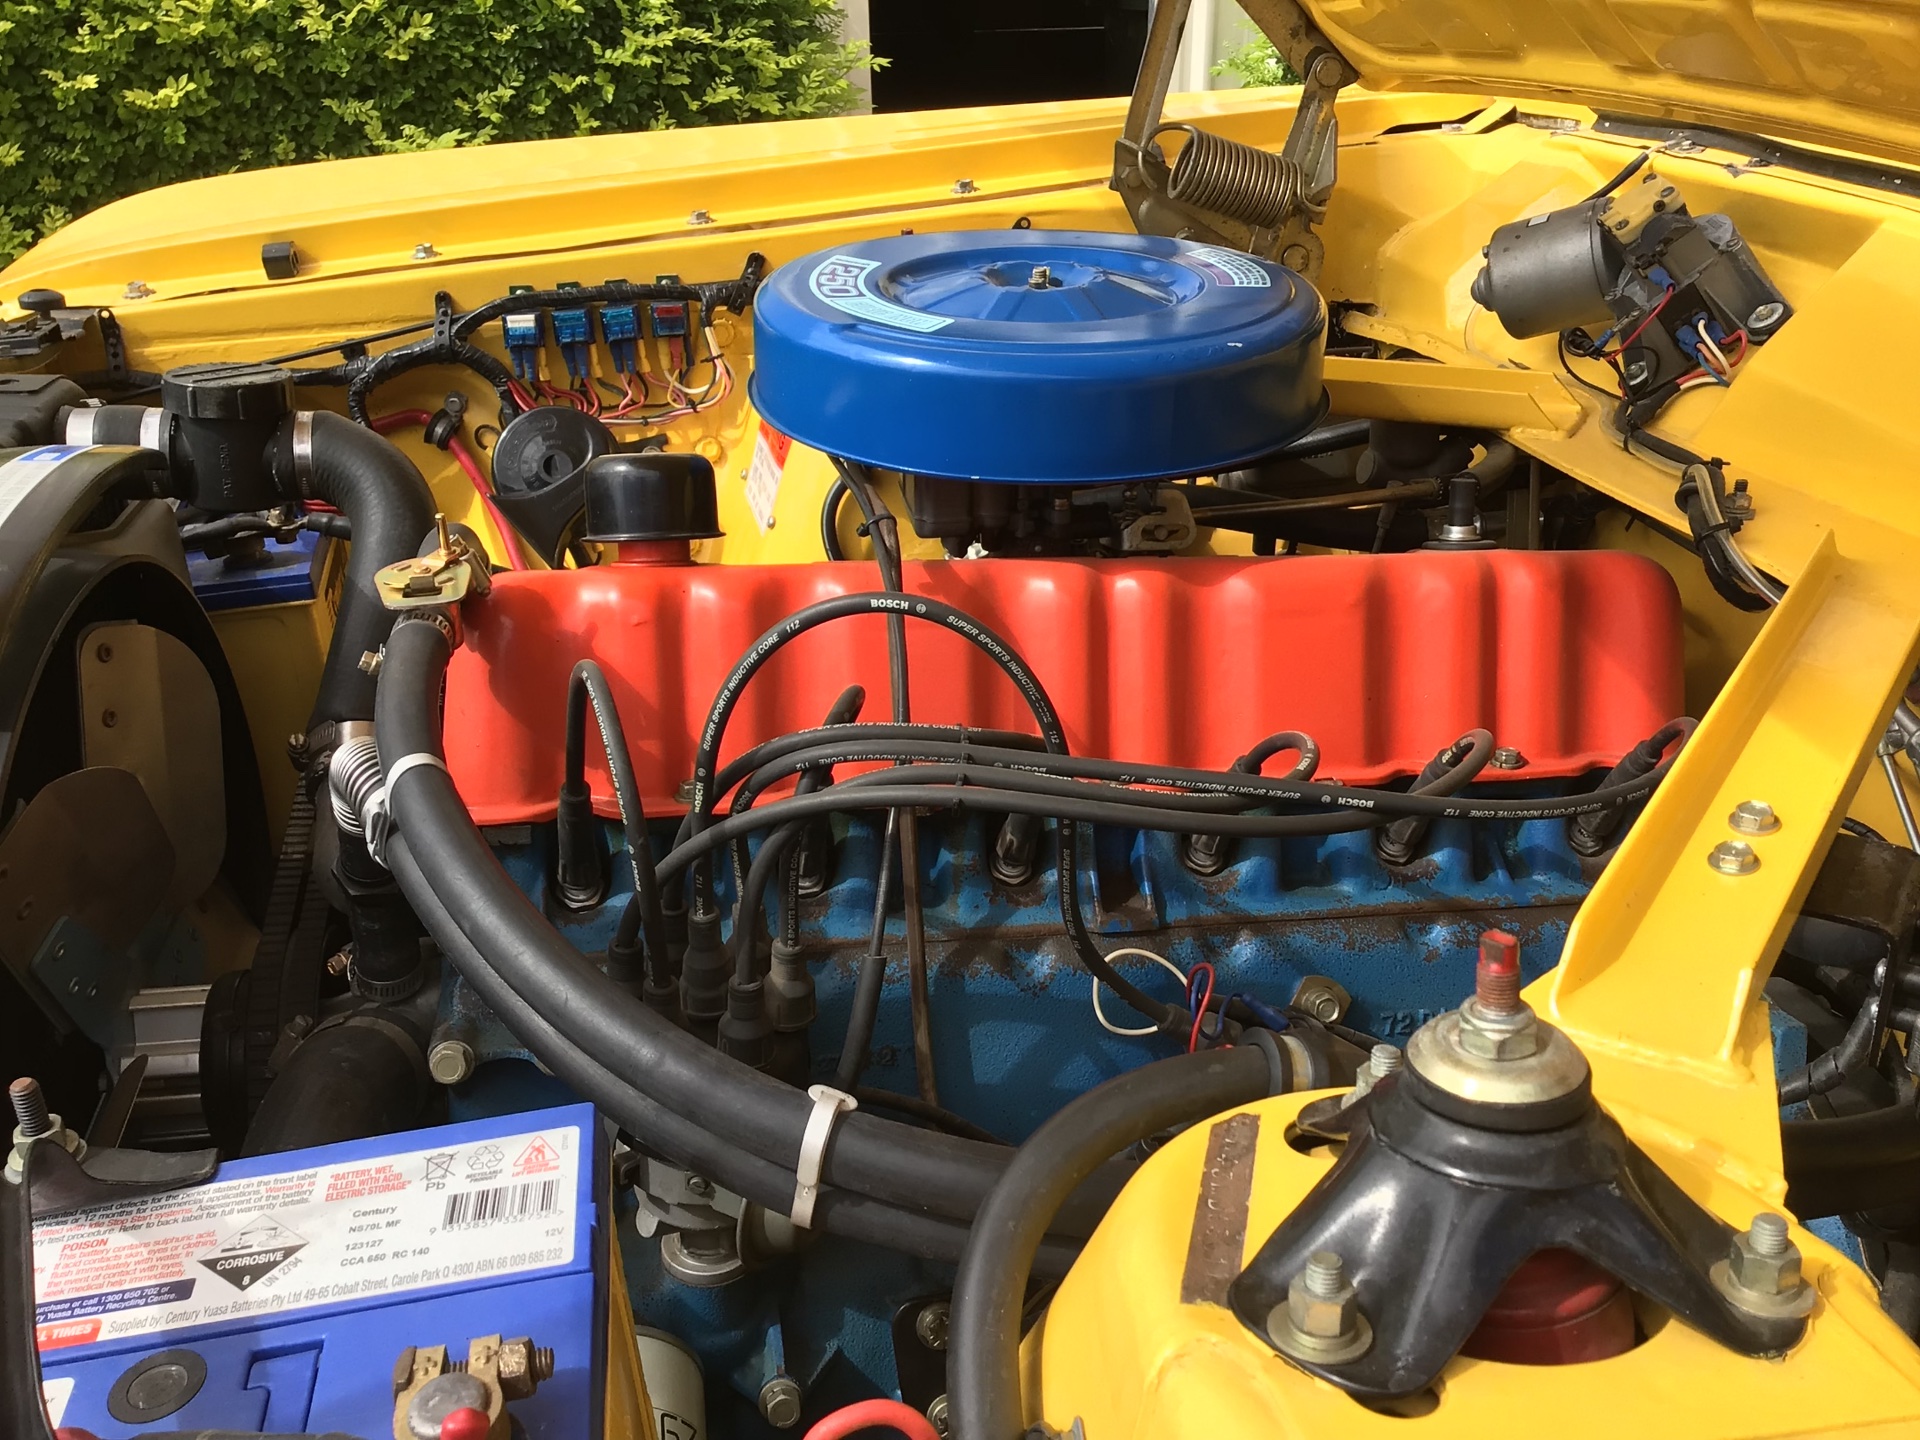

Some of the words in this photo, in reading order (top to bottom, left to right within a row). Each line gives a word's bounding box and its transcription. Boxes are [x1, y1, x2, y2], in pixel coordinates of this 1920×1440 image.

[818, 263, 862, 297] 250
[870, 598, 909, 610] BOSCH
[947, 615, 979, 636] SUPER
[978, 634, 1011, 662] SPORTS
[593, 698, 609, 746] INDUCTIVE
[694, 781, 704, 813] BOSCH
[703, 722, 716, 751] SUPER
[711, 689, 731, 723] SPORTS
[727, 650, 759, 692] INDUCTIVE
[758, 632, 780, 654] CORE
[786, 619, 800, 633] 112
[605, 747, 620, 788] SPORTS
[1175, 780, 1226, 791] INDUCTIVE
[1227, 785, 1265, 796] SPORTS
[1267, 789, 1301, 800] SUPER
[616, 791, 628, 825] SUPER
[1338, 796, 1374, 808] BOSCH
[1444, 808, 1460, 816] 112
[1542, 806, 1576, 818] SPORTS
[1576, 802, 1602, 814] SUPER
[1468, 809, 1495, 818] CORE
[1495, 809, 1543, 818] INDUCTIVE
[788, 871, 797, 908] INDUCTIVE
[788, 909, 796, 938] SPORTS
[115, 1199, 149, 1211] defects
[150, 1195, 164, 1206] for
[165, 1193, 180, 1201] the
[181, 1187, 211, 1201] period
[212, 1184, 241, 1196] stated
[256, 1178, 272, 1188] the
[273, 1175, 296, 1185] front
[296, 1171, 319, 1182] label
[327, 1180, 356, 1192] FILLED
[358, 1175, 384, 1187] WITH
[385, 1172, 403, 1184] ACID
[425, 1181, 446, 1192] Pb
[84, 1214, 97, 1222] 12
[97, 1208, 133, 1220] months
[135, 1206, 148, 1215] for
[149, 1196, 205, 1212] commercial
[265, 1182, 306, 1195] Warranty
[325, 1187, 366, 1202] ELECTRIC
[130, 1213, 153, 1223] Start
[195, 1197, 253, 1212] Assessment
[253, 1196, 264, 1204] of
[265, 1192, 280, 1202] the
[281, 1188, 315, 1200] battery
[352, 1205, 398, 1218] Century
[118, 1223, 142, 1233] Refer
[145, 1221, 155, 1229] to
[156, 1217, 179, 1228] back
[181, 1213, 204, 1224] label
[205, 1211, 219, 1220] for
[220, 1207, 235, 1218] full
[236, 1203, 277, 1215] warranty
[348, 1221, 383, 1234] NS70L
[385, 1219, 402, 1229] MF
[429, 1227, 437, 1236] 9
[545, 1227, 565, 1238] 12V
[61, 1238, 109, 1253] POISON
[62, 1259, 82, 1269] acid
[83, 1255, 123, 1267] contacts
[147, 1246, 169, 1257] eyes
[182, 1237, 217, 1250] clothing
[79, 1247, 112, 1258] battery
[112, 1242, 151, 1253] contains
[345, 1239, 384, 1251] 123127
[75, 1261, 131, 1276] immediately
[133, 1256, 154, 1266] with
[216, 1250, 285, 1271] CORROSIVE
[340, 1255, 365, 1267] CCA
[367, 1252, 387, 1263] 650
[391, 1249, 408, 1260] RC
[411, 1247, 430, 1257] 140
[63, 1275, 89, 1286] event
[103, 1268, 138, 1280] contact
[140, 1263, 160, 1274] with
[242, 1275, 251, 1286] 8
[261, 1273, 280, 1288] UN
[278, 1256, 304, 1276] 2794
[67, 1282, 105, 1295] medical
[106, 1277, 127, 1289] help
[83, 1296, 98, 1306] call
[101, 1293, 122, 1304] 1300
[123, 1290, 141, 1300] 650
[142, 1287, 160, 1297] 702
[161, 1285, 171, 1293] or
[108, 1318, 148, 1334] Supplied
[150, 1314, 163, 1328] by:
[165, 1308, 201, 1324] Century
[203, 1305, 229, 1318] Yuasa
[230, 1298, 269, 1314] Batteries
[270, 1293, 285, 1308] Pty
[287, 1290, 301, 1304] Ltd
[303, 1285, 330, 1300] 49-65
[331, 1280, 361, 1297] Cobalt
[361, 1276, 389, 1293] Street,
[391, 1271, 419, 1287] Carole
[421, 1267, 441, 1281] Park
[443, 1265, 450, 1279] Q
[452, 1261, 474, 1275] 4300
[475, 1257, 495, 1274] ABN
[496, 1256, 508, 1269] 66
[510, 1253, 527, 1267] 009
[528, 1249, 545, 1264] 685
[546, 1247, 563, 1261] 232
[47, 1310, 72, 1321] Yuasa
[73, 1305, 104, 1318] Battery
[106, 1299, 146, 1312] Recycling
[52, 1323, 93, 1340] TIMES
